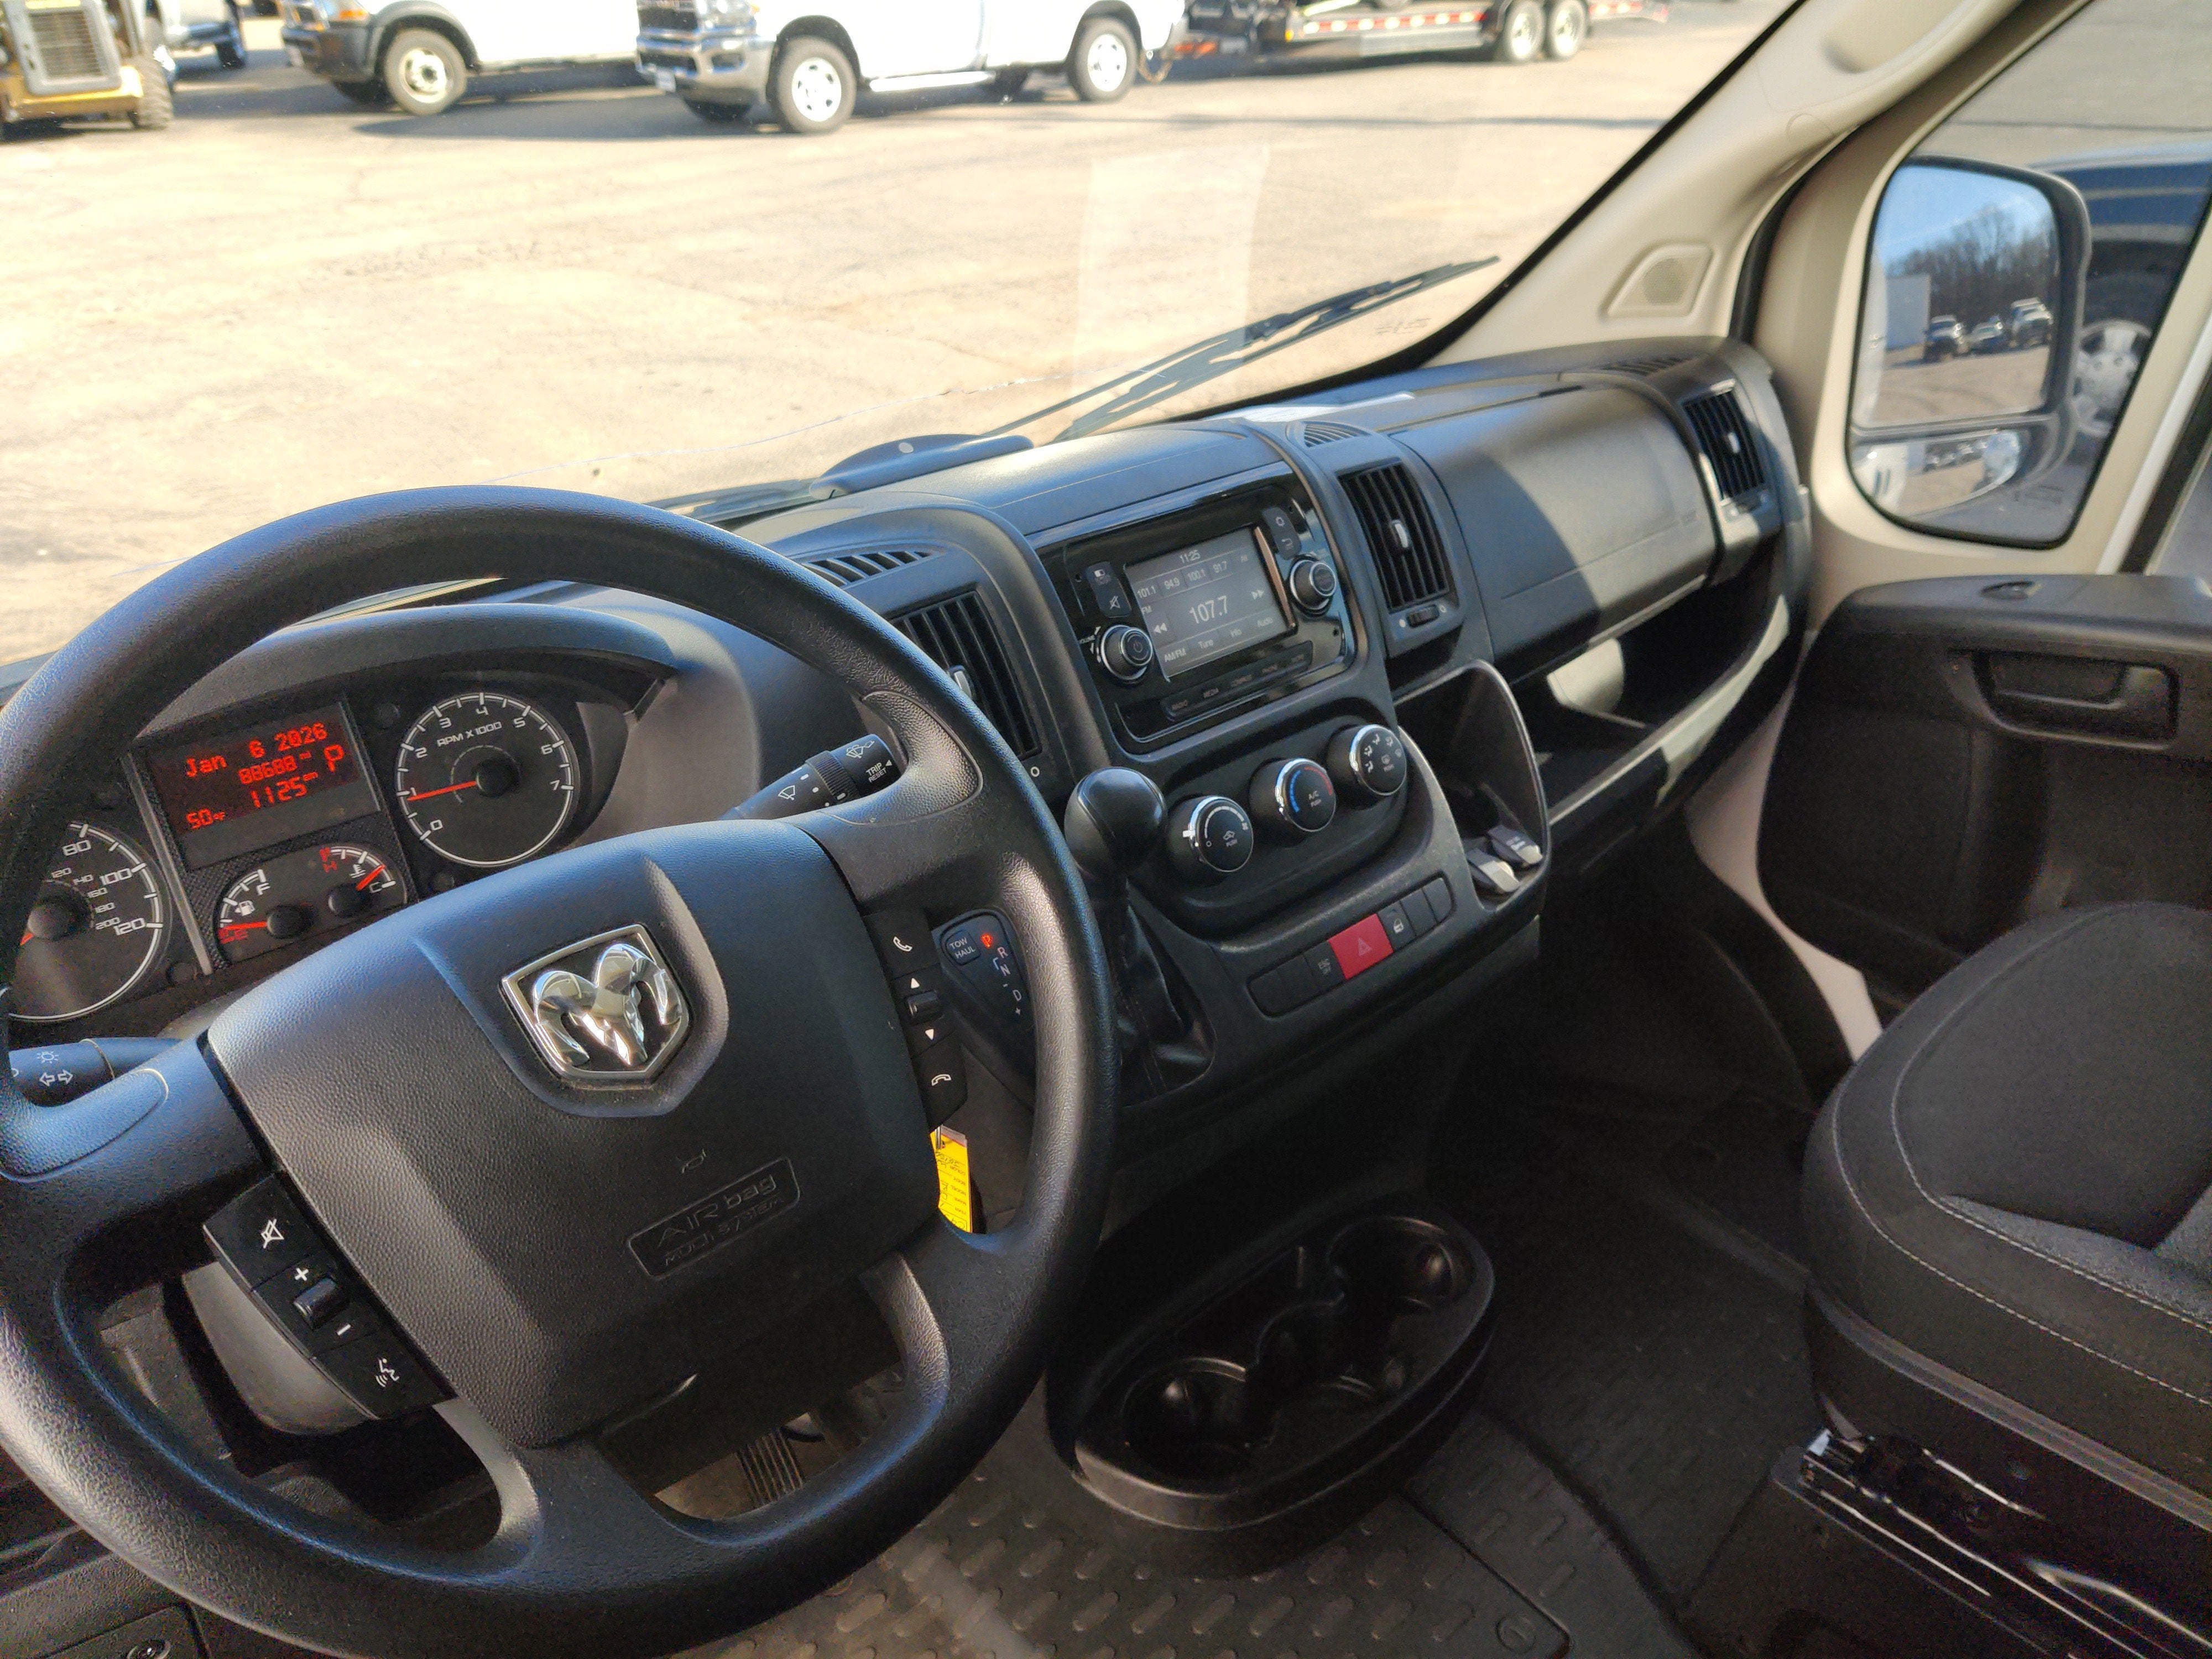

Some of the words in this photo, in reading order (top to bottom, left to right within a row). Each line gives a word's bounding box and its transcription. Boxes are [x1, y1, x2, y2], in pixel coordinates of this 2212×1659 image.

[1137, 586, 1156, 598] 101.1
[1164, 577, 1180, 590] 94.9
[1141, 605, 1152, 615] FM
[1190, 596, 1228, 624] 107.7
[1164, 648, 1186, 662] AM/FM
[1198, 639, 1214, 649] Tune
[476, 706, 488, 716] 4
[439, 717, 451, 728] 3
[513, 717, 526, 728] 5
[436, 733, 463, 747] RPM
[475, 721, 503, 735] 1000
[187, 755, 227, 778] Jan
[249, 740, 265, 758] 6
[274, 722, 327, 752] 2026
[415, 747, 428, 758] 2
[541, 744, 554, 755] 6
[324, 744, 344, 773] P
[866, 763, 882, 776] TRIP
[868, 767, 886, 782] RESET
[550, 780, 560, 791] 7
[430, 819, 443, 831] 0
[62, 840, 91, 856] 80
[51, 867, 72, 878] 120
[100, 868, 132, 885] 100
[73, 874, 94, 885] 140
[87, 887, 108, 898] 160
[257, 883, 270, 895] F
[369, 881, 383, 893] C
[95, 902, 116, 913] 180
[95, 917, 121, 930] 200
[113, 917, 146, 936] 120
[950, 937, 968, 949] TOW
[981, 934, 993, 949] P
[954, 946, 976, 959] HAUL
[997, 947, 1008, 958] R
[1000, 964, 1010, 977] N
[1013, 989, 1022, 1001] D
[658, 1203, 718, 1248] AIR
